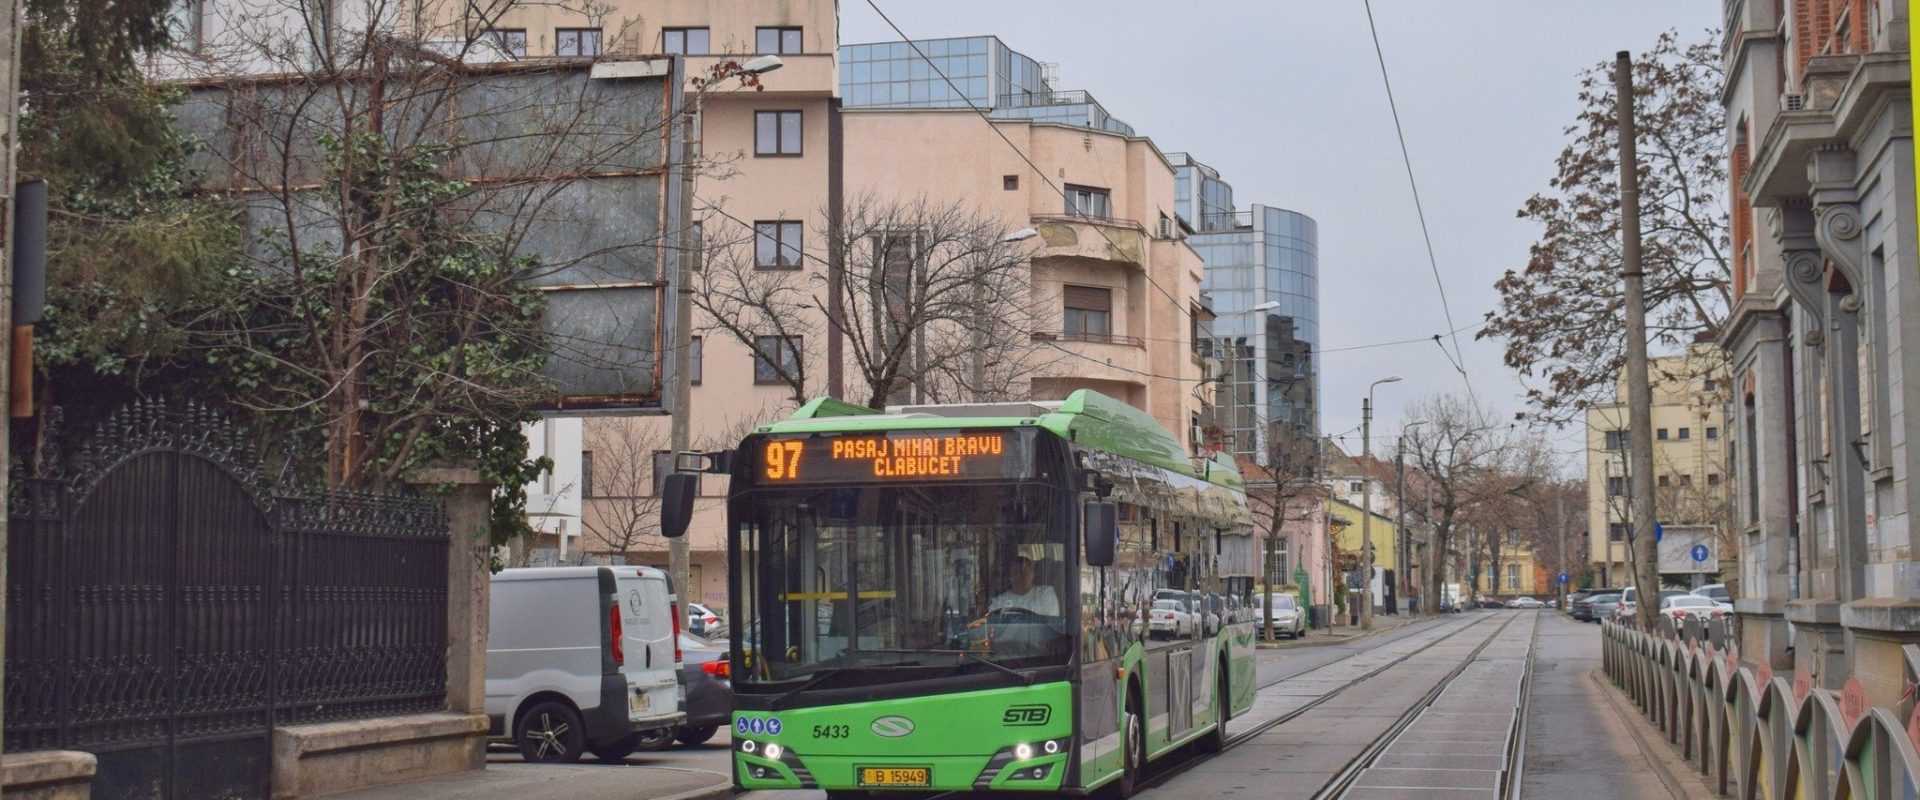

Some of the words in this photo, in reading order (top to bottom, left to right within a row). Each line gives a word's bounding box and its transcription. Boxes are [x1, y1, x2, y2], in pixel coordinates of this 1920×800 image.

[833, 439, 888, 459] PASAJ
[893, 438, 939, 457] MIHAI
[945, 436, 1002, 455] BRAVU
[766, 441, 803, 479] 97
[874, 456, 961, 476] CLABUCET
[1002, 707, 1047, 723] STB
[812, 725, 850, 739] 5433
[875, 770, 885, 783] B
[891, 770, 925, 783] 15949
